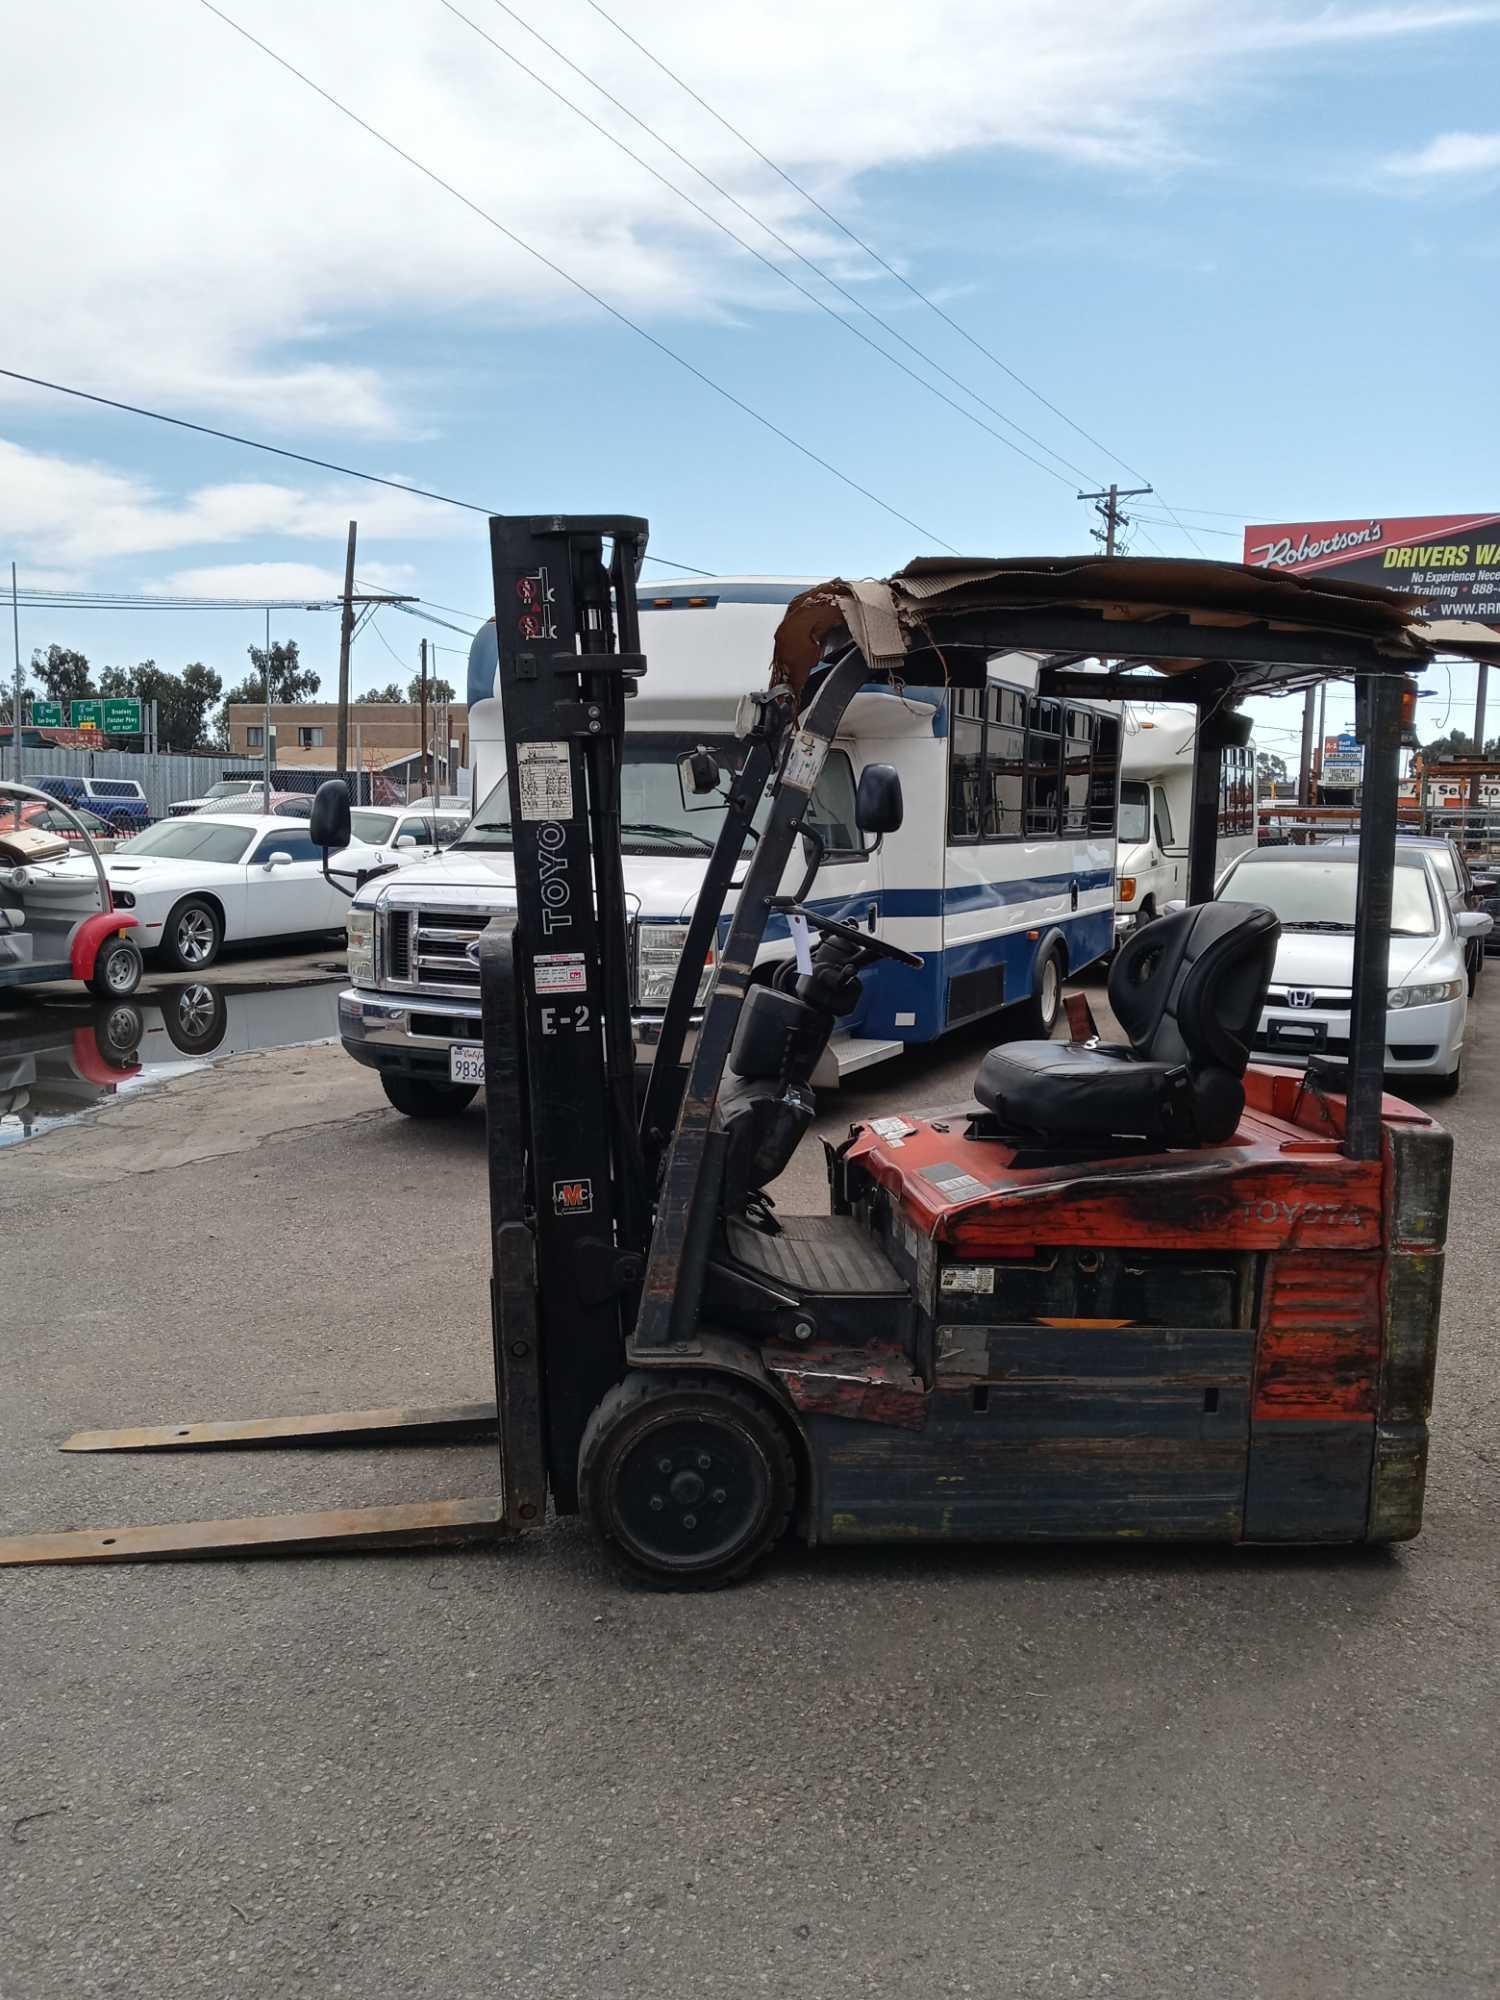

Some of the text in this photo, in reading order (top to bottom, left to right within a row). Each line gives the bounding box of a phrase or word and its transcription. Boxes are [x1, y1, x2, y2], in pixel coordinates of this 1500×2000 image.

[1250, 520, 1382, 568] Robertson's
[1383, 545, 1470, 568] DRIVERS
[1411, 572, 1423, 583] No
[1426, 571, 1476, 584] Experience
[1413, 585, 1458, 598] Training
[1471, 583, 1500, 595] 888-
[541, 1005, 591, 1035] E-2
[558, 1183, 589, 1206] AMC
[1239, 1199, 1363, 1226] TOYOTA
